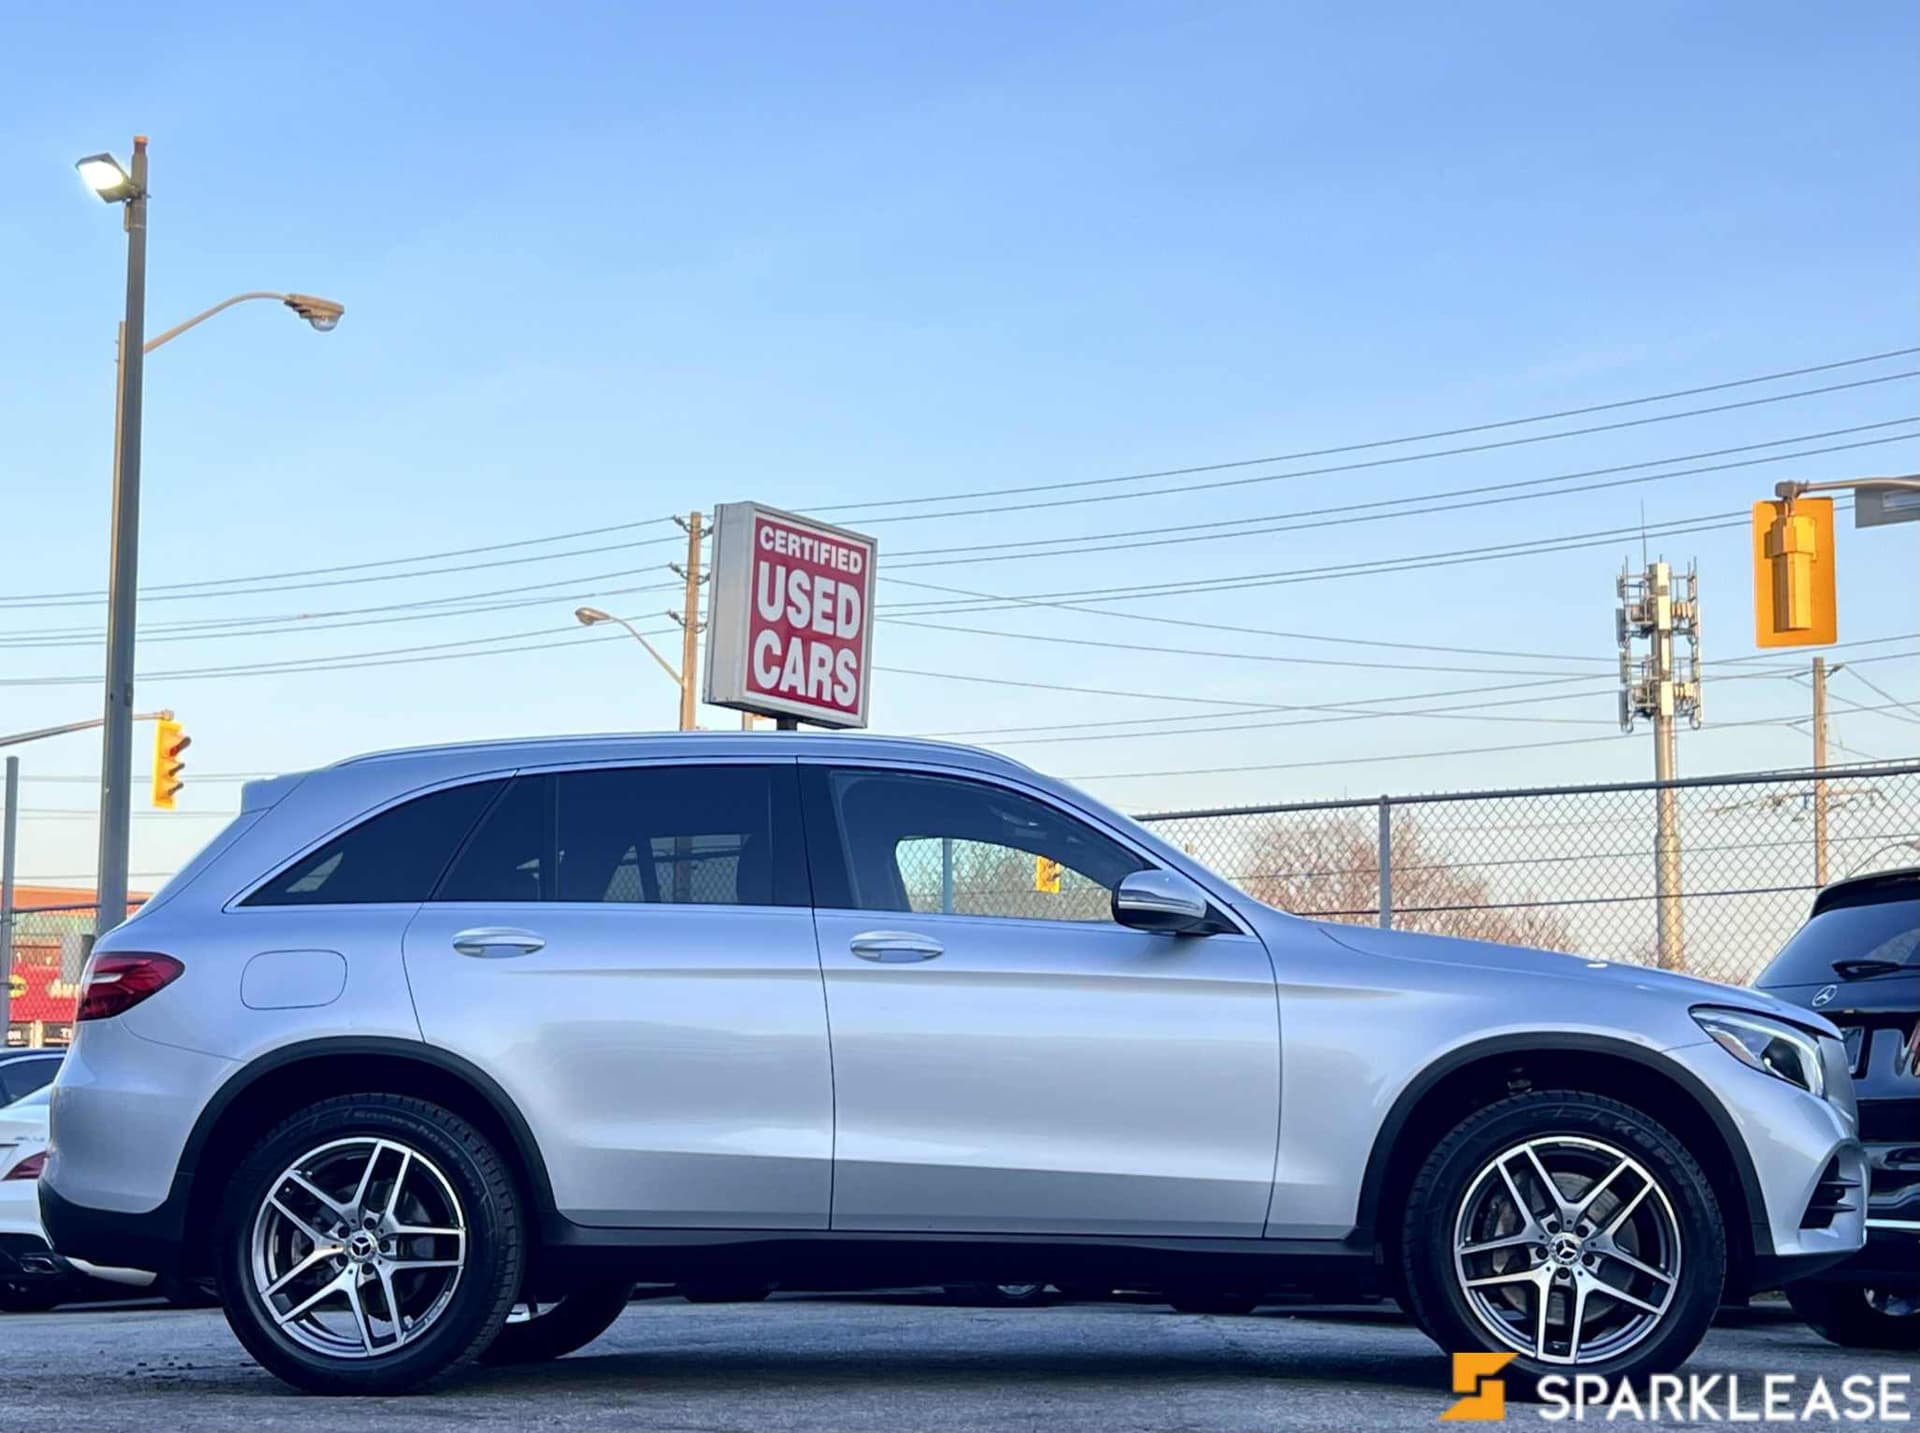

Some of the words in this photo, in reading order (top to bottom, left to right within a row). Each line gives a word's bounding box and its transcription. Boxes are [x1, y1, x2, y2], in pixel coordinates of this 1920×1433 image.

[759, 525, 863, 574] CERTIFIED
[757, 561, 862, 640] USED
[753, 629, 858, 707] CARS
